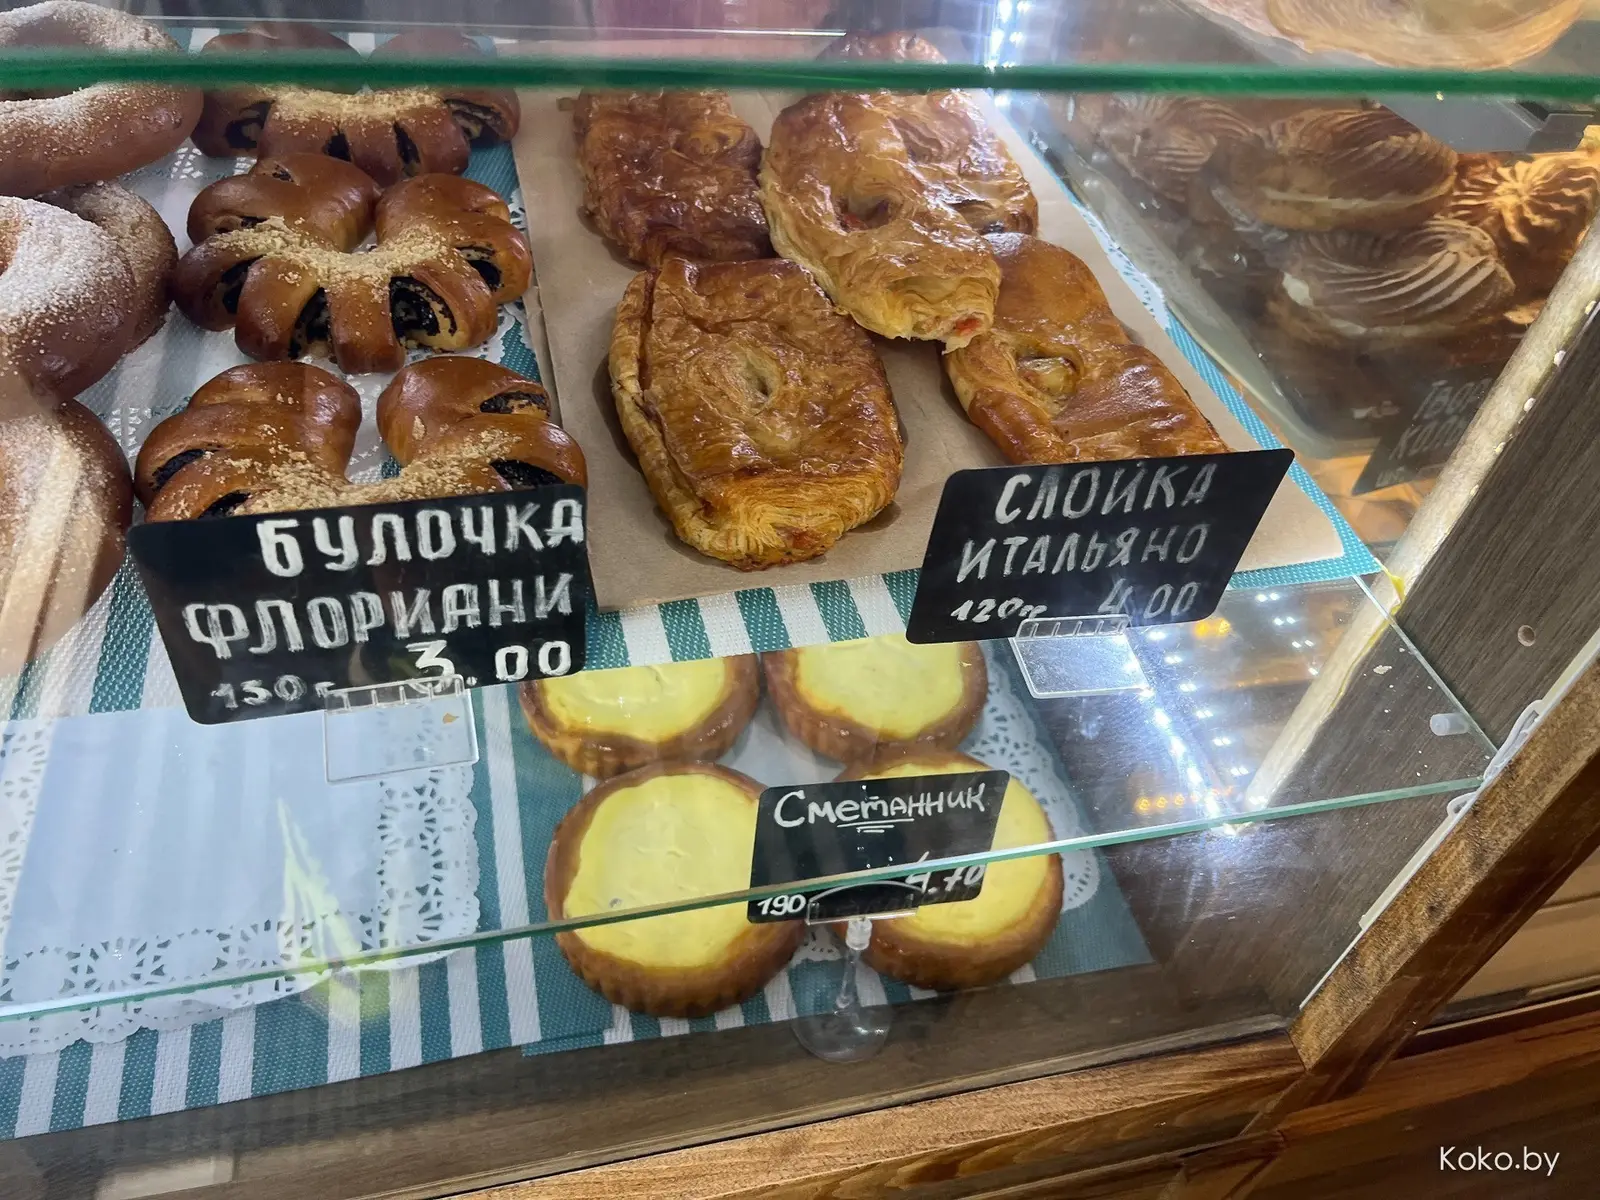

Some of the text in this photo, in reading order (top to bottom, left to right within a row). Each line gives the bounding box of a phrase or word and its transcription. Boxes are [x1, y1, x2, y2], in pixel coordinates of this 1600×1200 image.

[996, 462, 1214, 524] СЛОЙКА
[257, 500, 584, 576] БУЛОЧКА
[958, 525, 1208, 583] ИТАЛЬЯНО
[183, 574, 572, 659] ФЛОРИАНИ
[757, 894, 804, 916] 190
